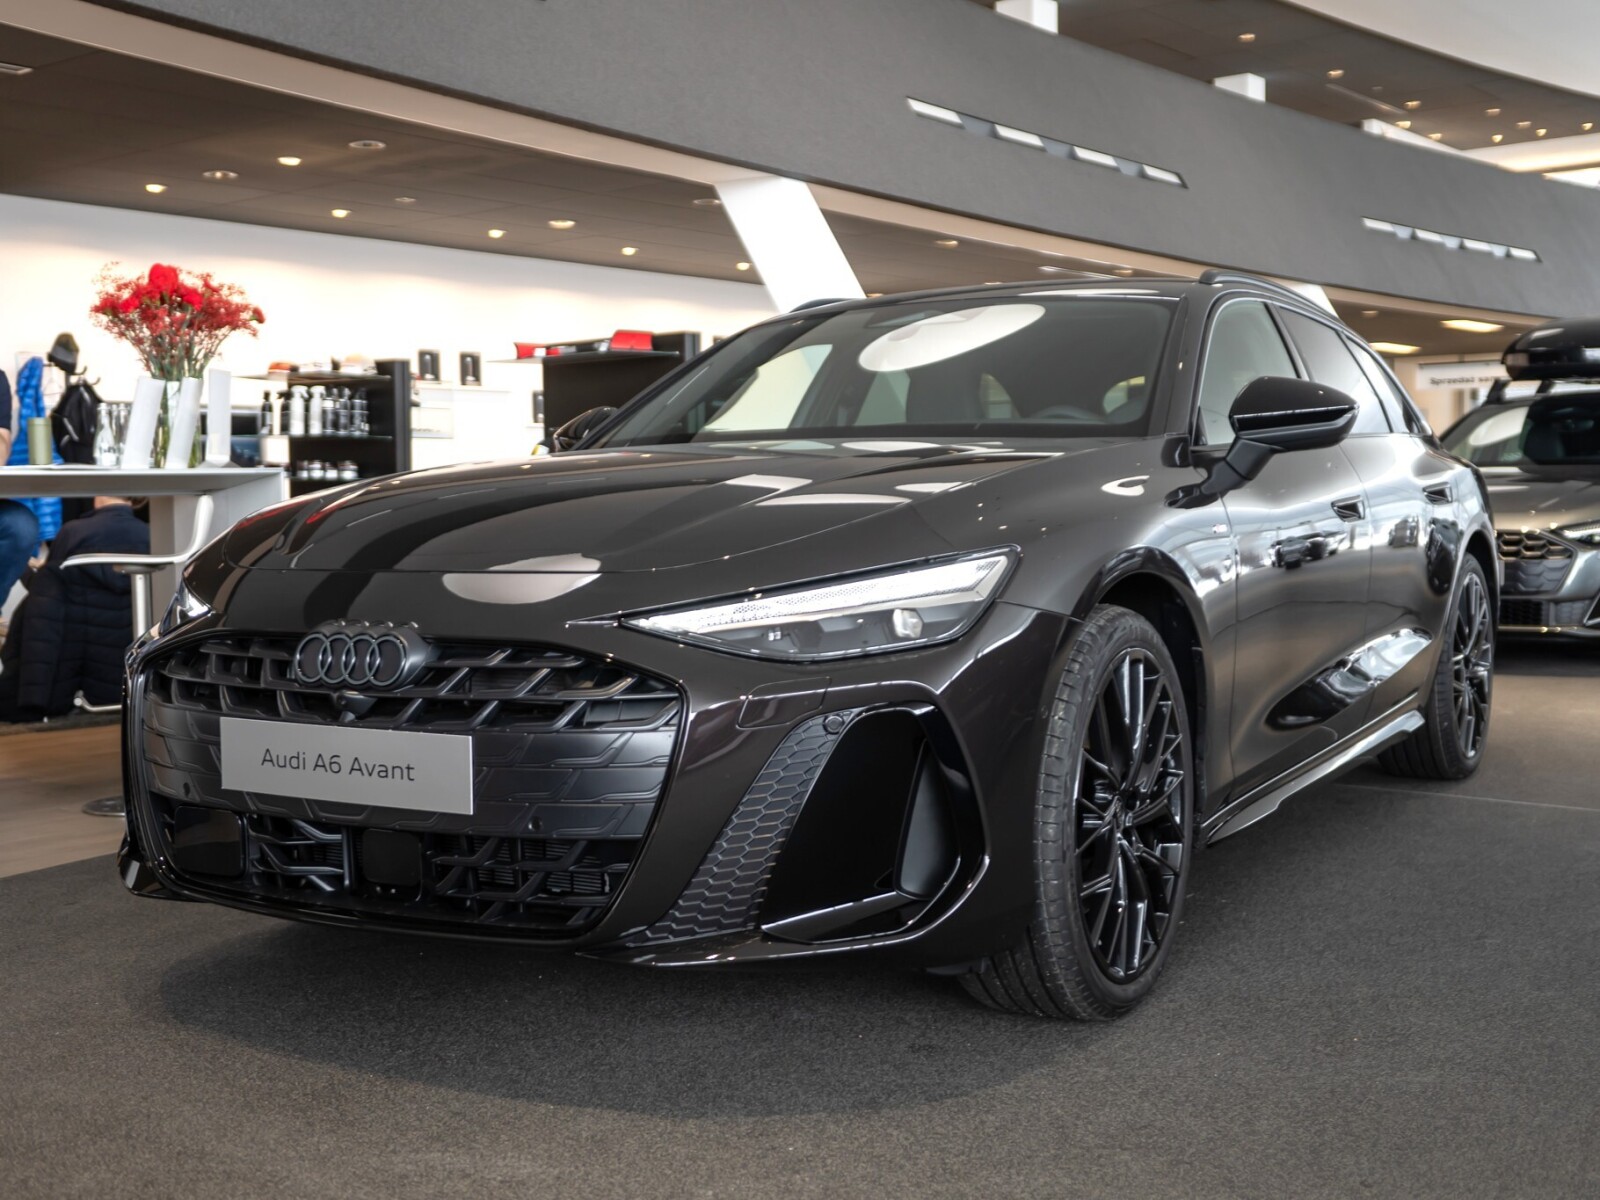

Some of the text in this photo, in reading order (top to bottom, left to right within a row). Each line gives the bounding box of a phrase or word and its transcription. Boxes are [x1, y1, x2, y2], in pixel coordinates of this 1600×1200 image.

[261, 748, 415, 781] Audi A6 Avant
